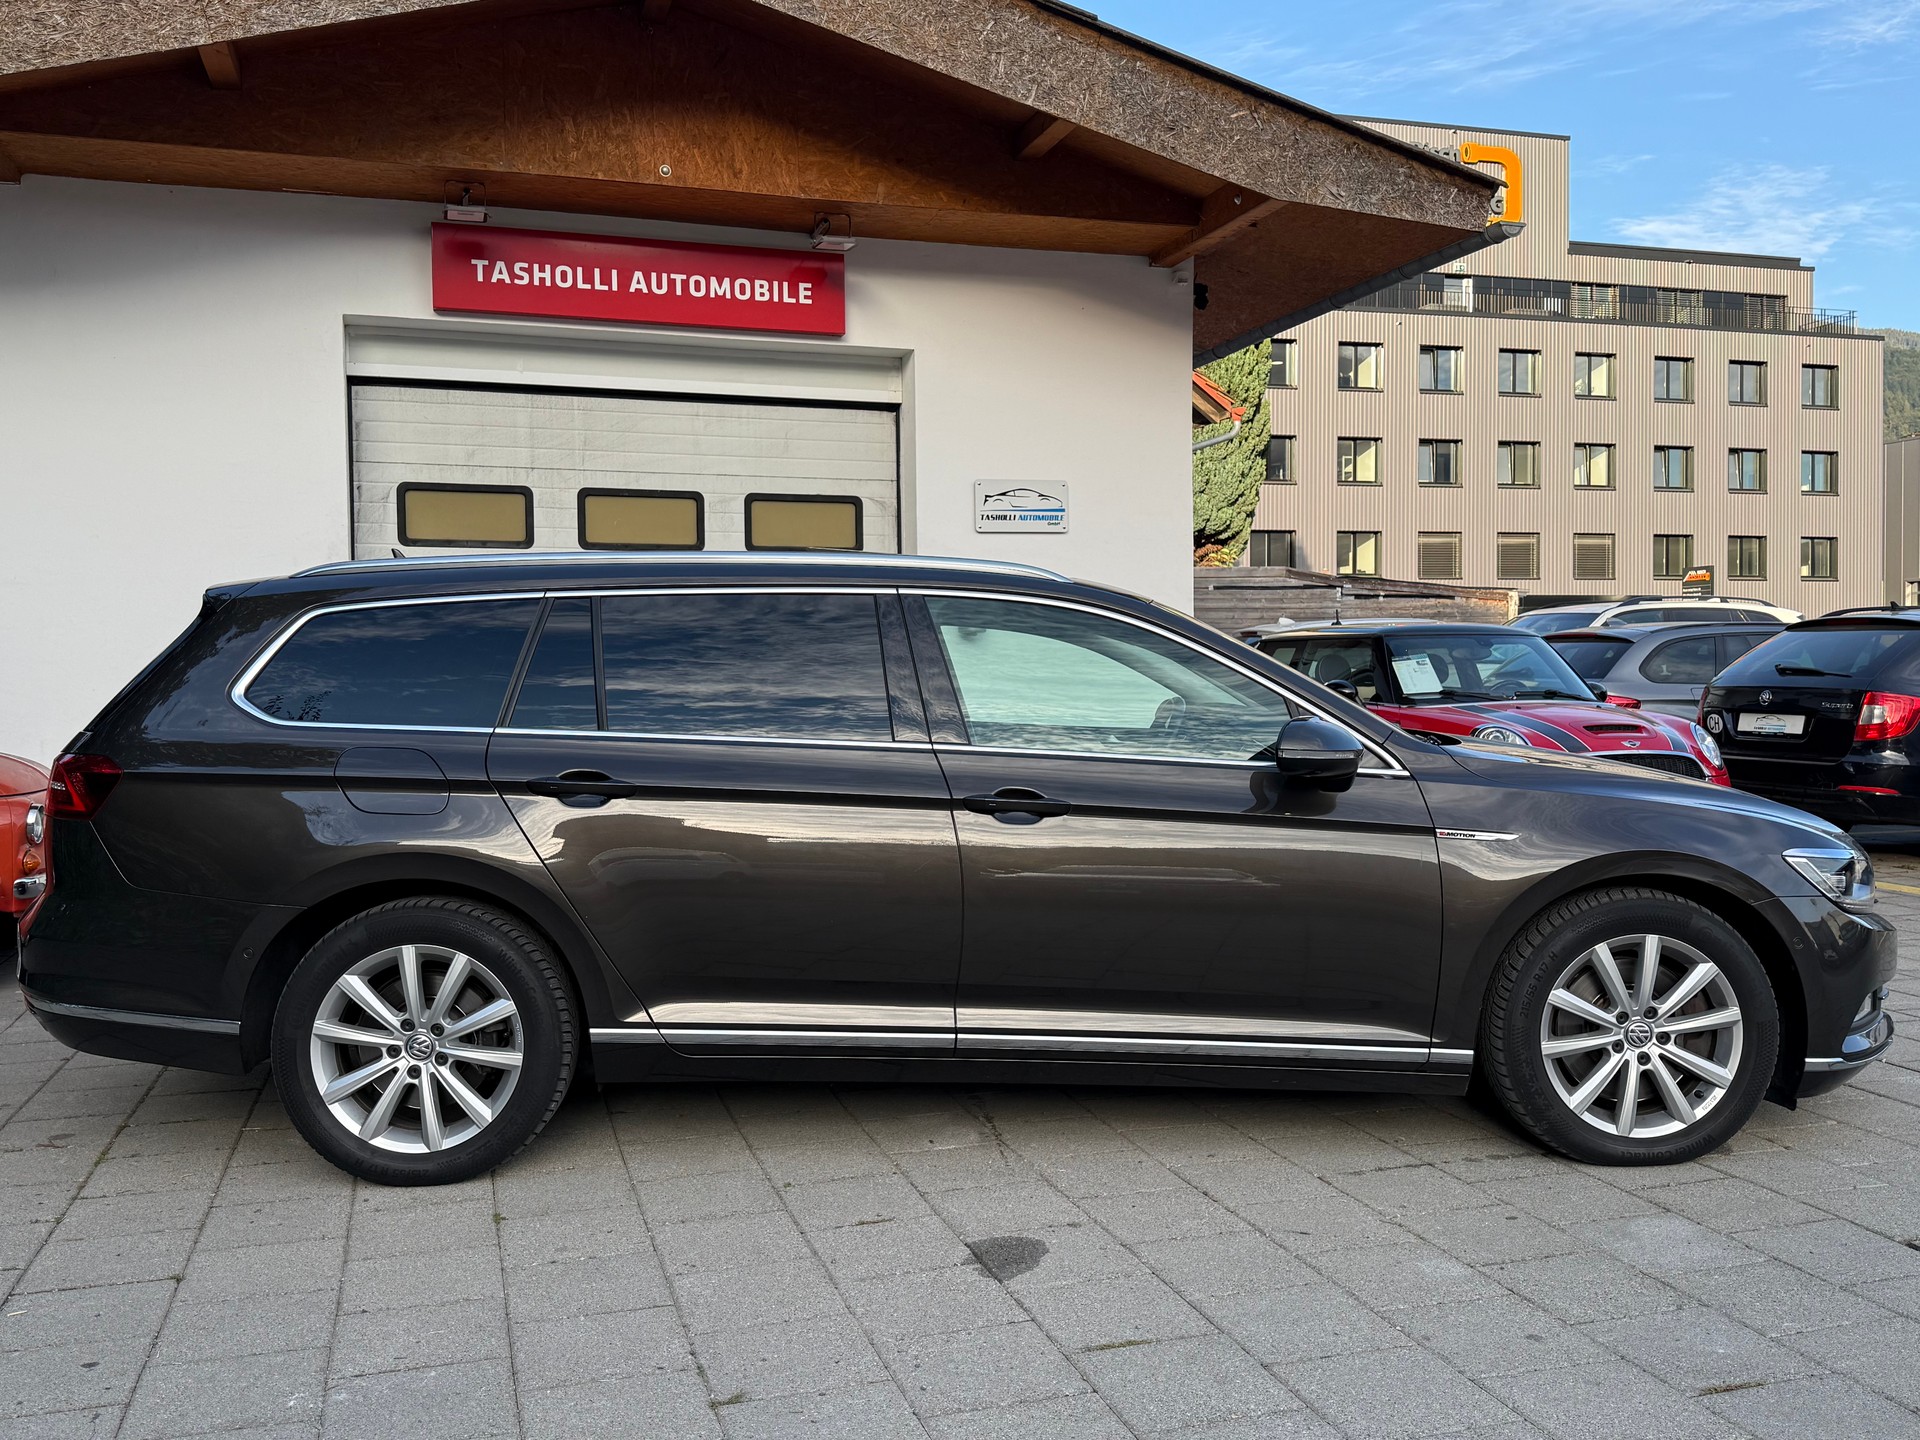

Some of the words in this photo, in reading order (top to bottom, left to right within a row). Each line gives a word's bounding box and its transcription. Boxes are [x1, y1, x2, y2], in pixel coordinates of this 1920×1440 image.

[471, 258, 618, 292] TASHOLLI
[629, 270, 814, 305] AUTOMOBILE
[1708, 716, 1721, 731] CH
[1519, 983, 1538, 1019] 215/55
